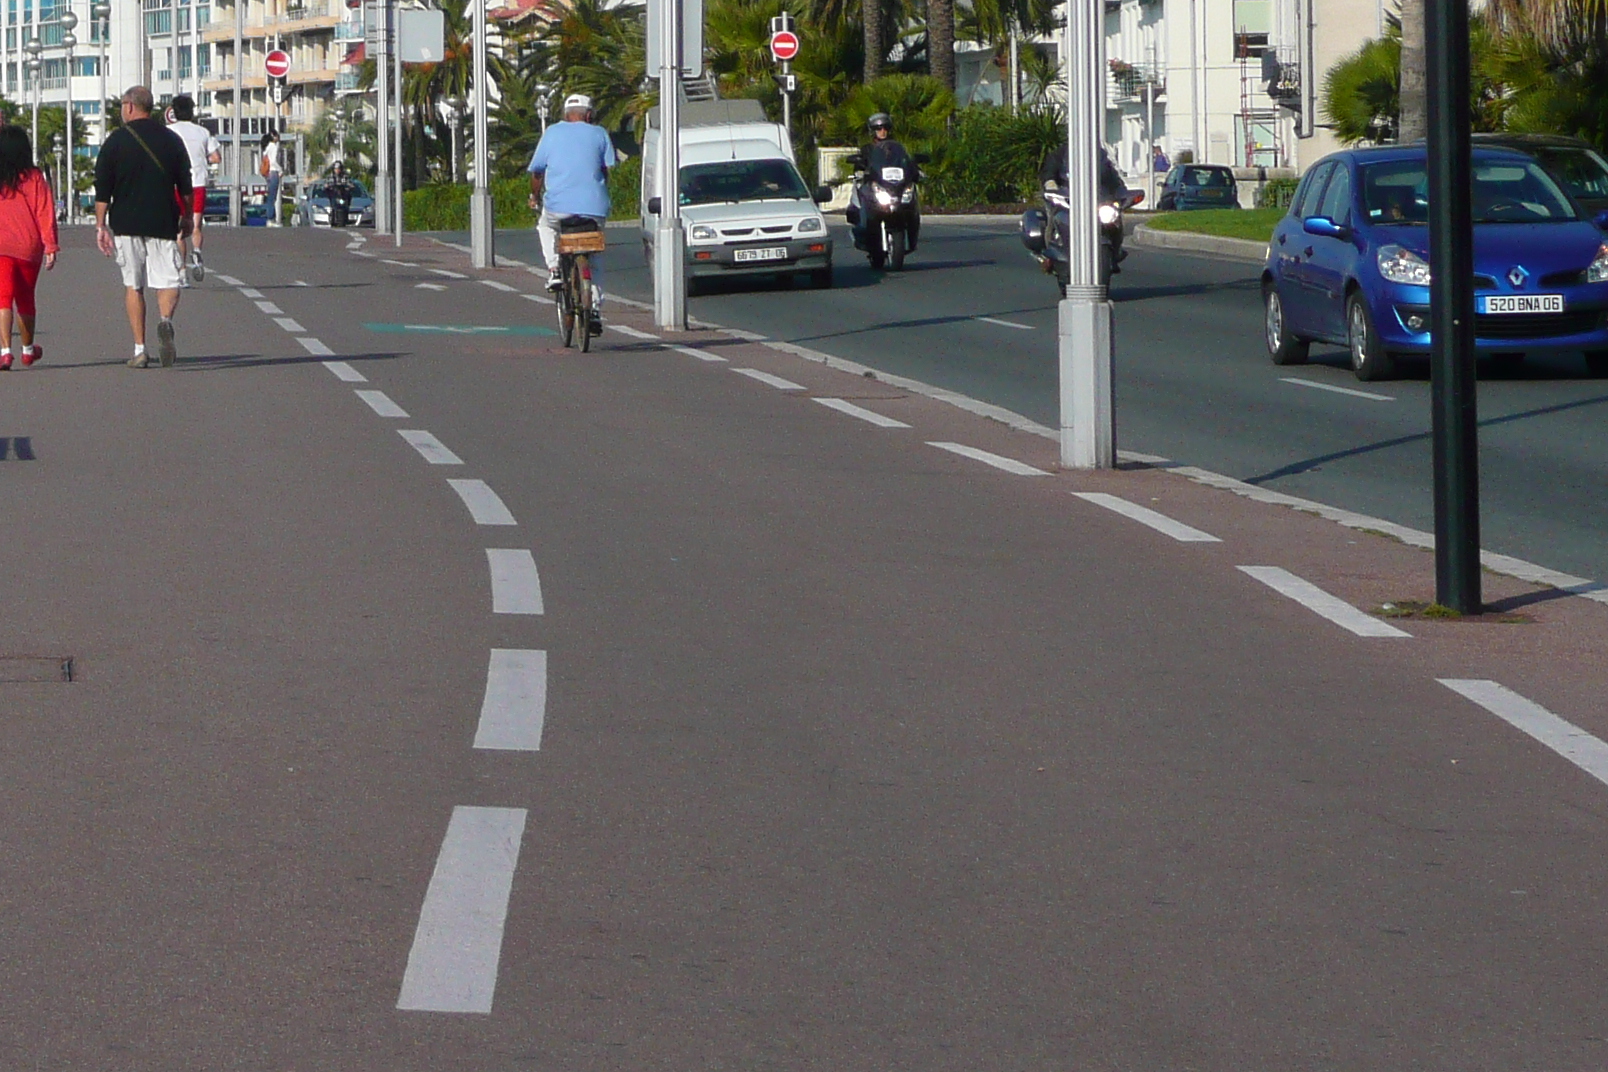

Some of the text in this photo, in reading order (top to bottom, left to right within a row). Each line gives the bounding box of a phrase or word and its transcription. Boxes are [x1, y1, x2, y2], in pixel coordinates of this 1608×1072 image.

[1490, 297, 1559, 312] 520 BNA 06
